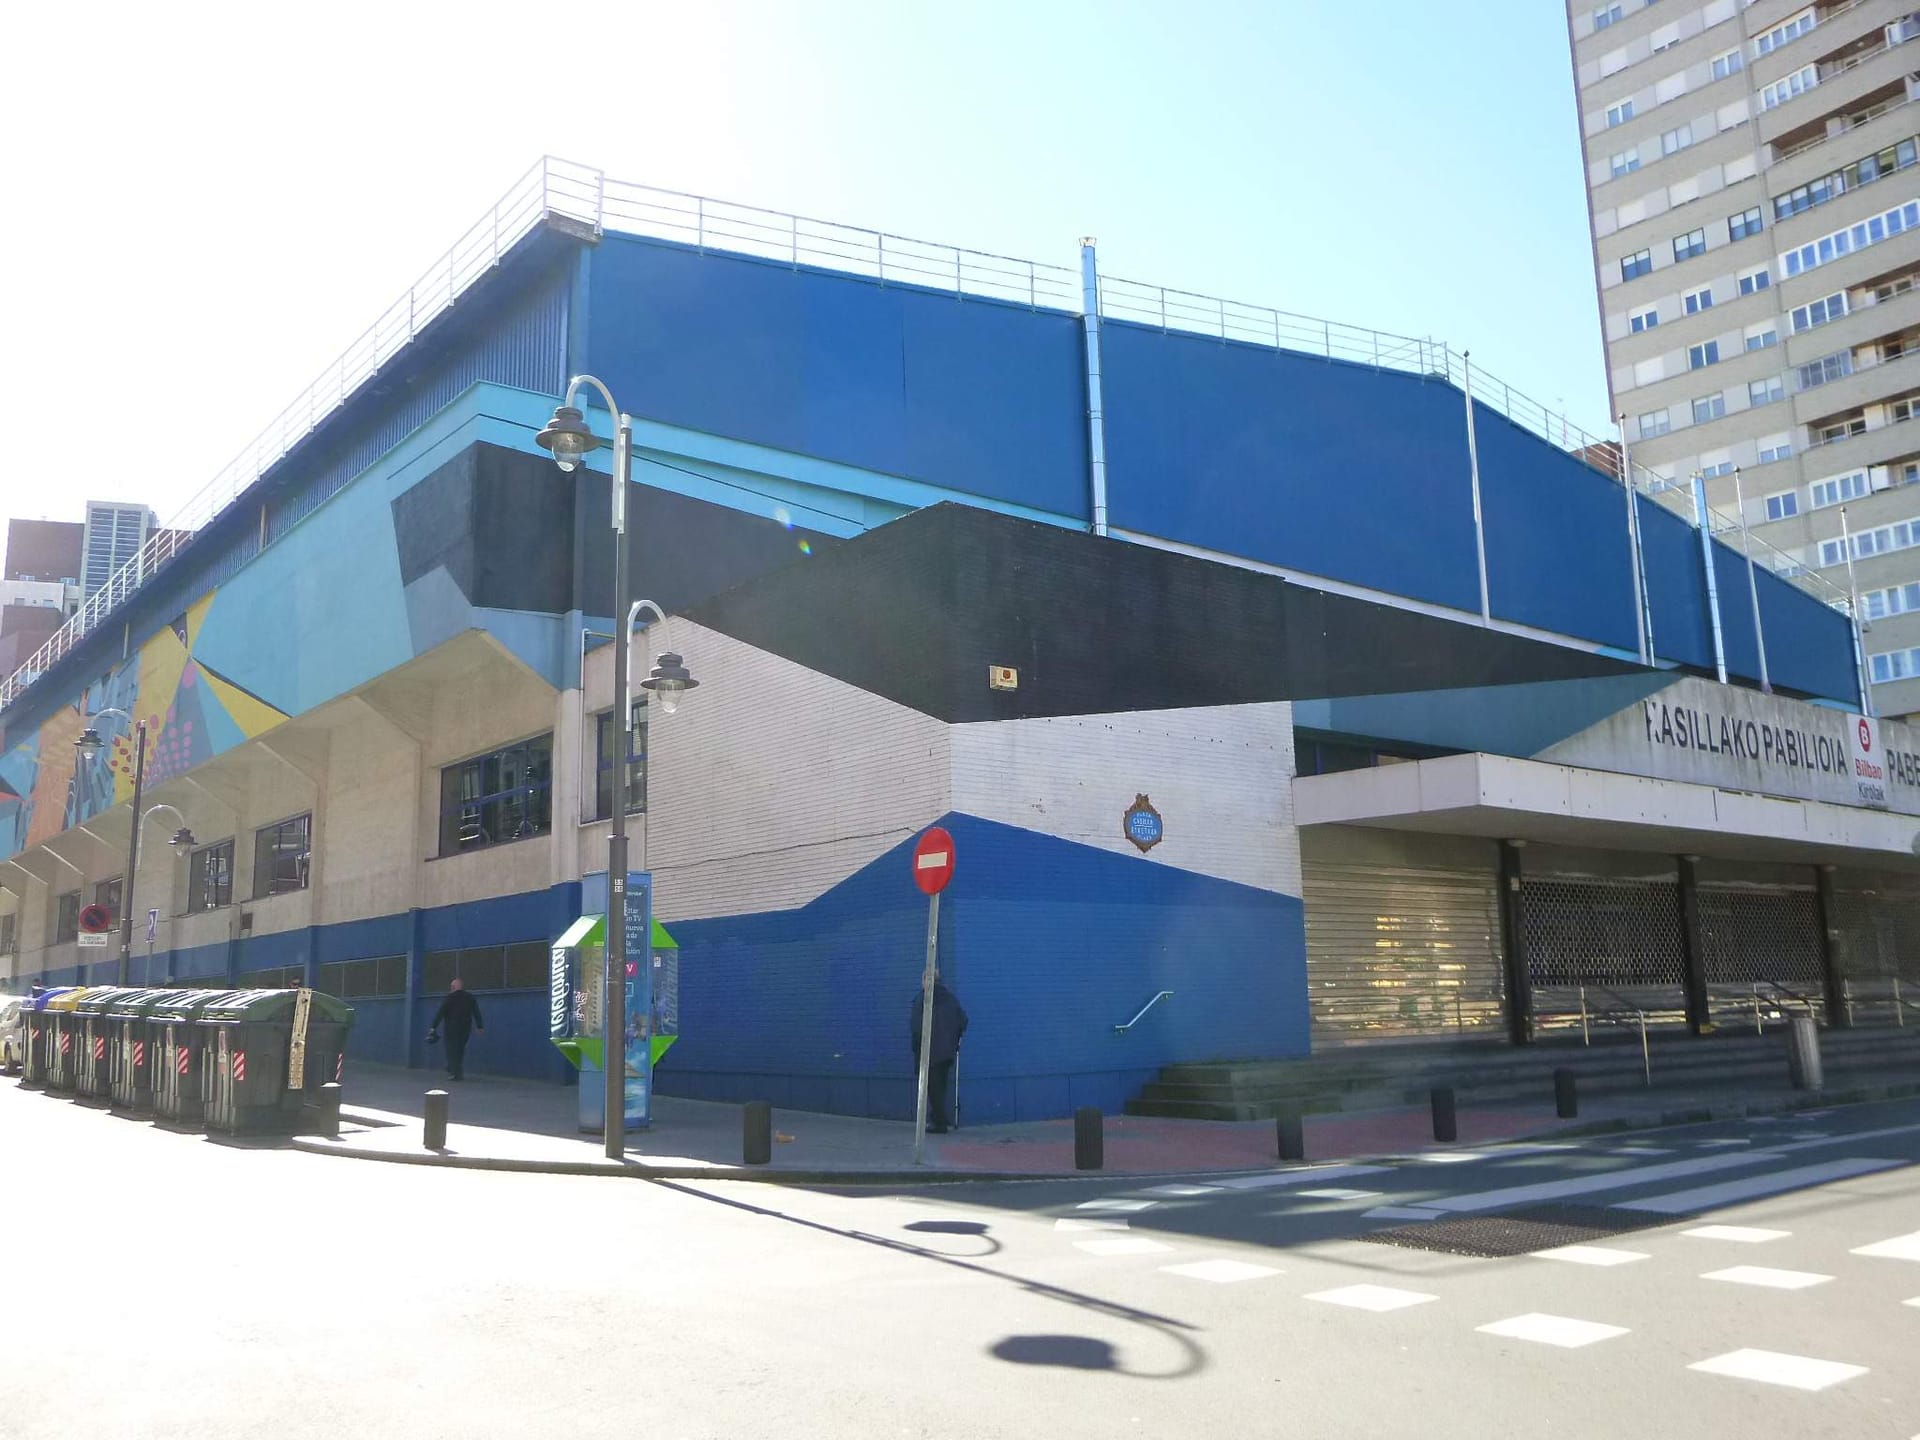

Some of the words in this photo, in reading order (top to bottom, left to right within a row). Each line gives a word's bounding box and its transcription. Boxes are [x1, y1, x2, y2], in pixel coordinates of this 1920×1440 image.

[1763, 724, 1848, 775] PABILIOIA
[1855, 758, 1882, 780] Bilbao
[1857, 781, 1884, 801] Kirolak
